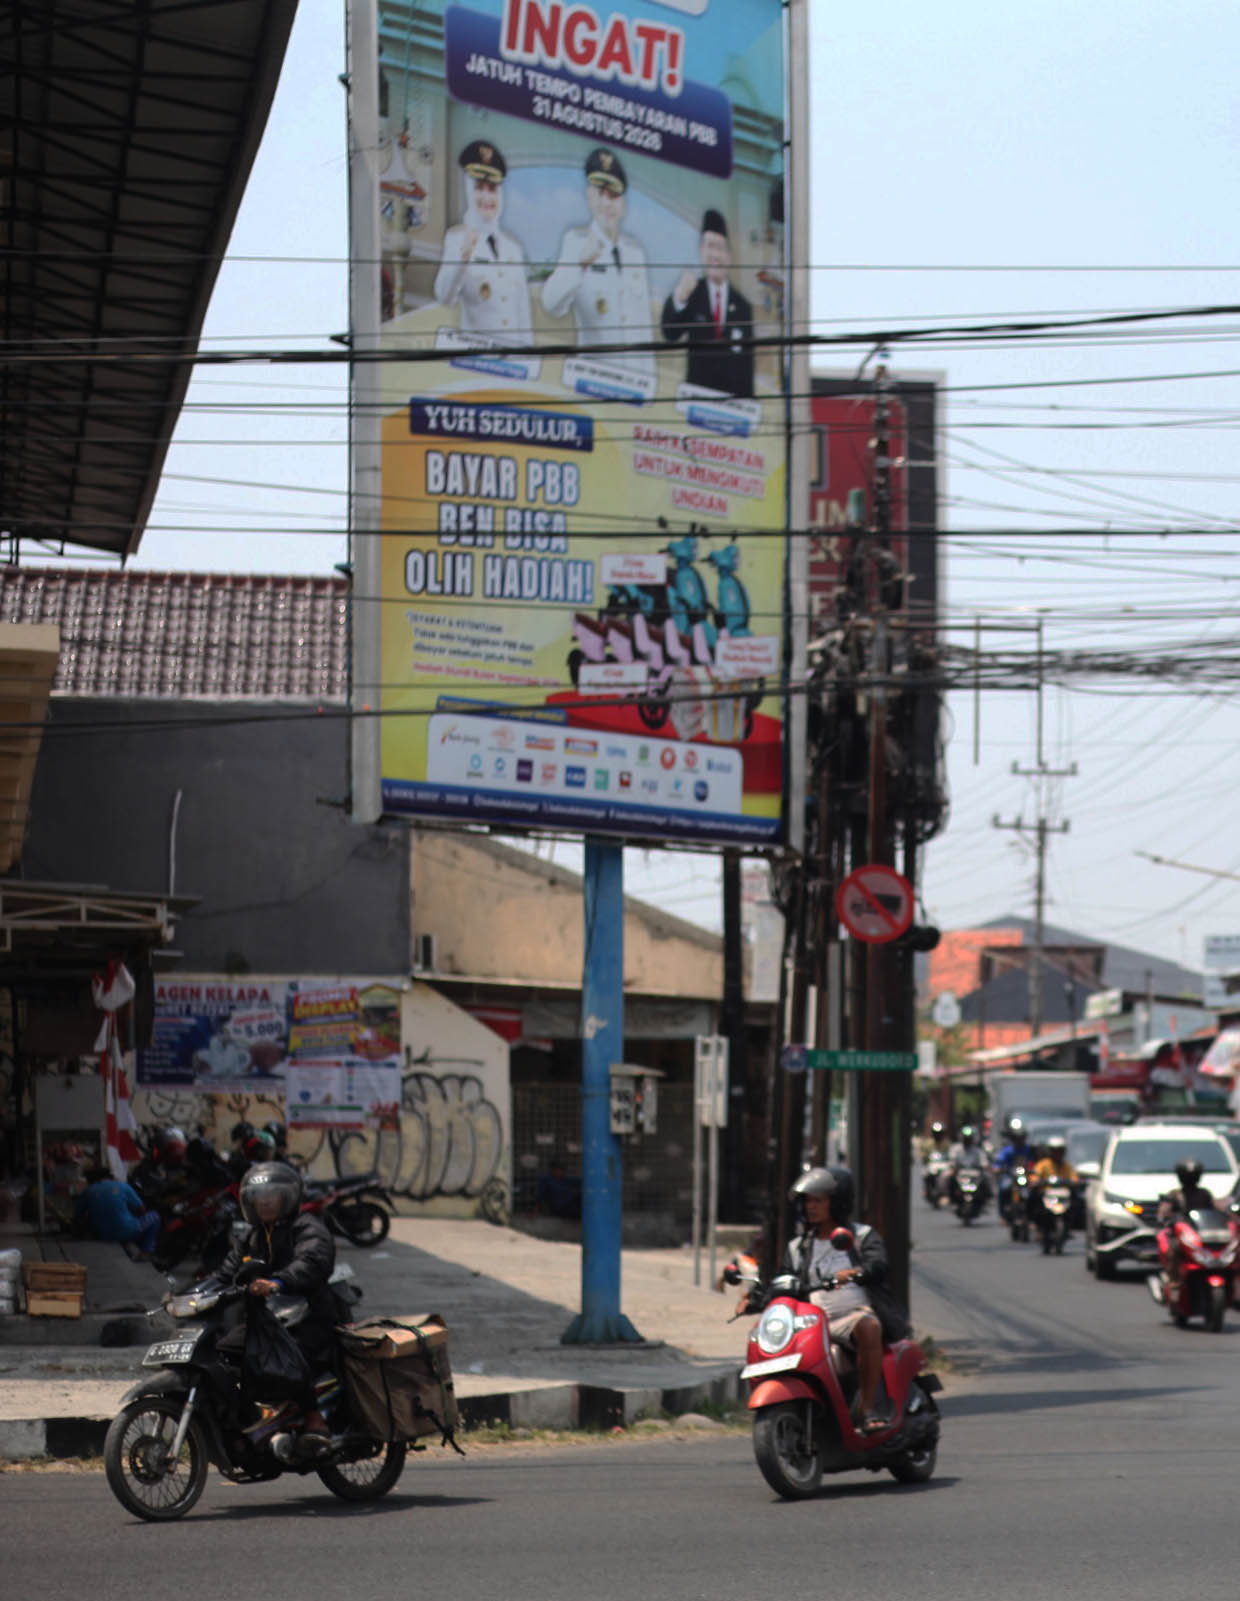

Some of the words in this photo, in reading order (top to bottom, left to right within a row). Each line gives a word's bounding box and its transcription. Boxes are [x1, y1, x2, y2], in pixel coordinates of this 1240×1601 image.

[504, 0, 684, 88] INGAT!
[465, 54, 523, 86] JATUH
[525, 70, 582, 103] TEMPO
[584, 88, 689, 137] PEMBAYARAN
[689, 120, 718, 147] PBB
[551, 100, 625, 142] AGUSTUS
[423, 404, 477, 432] YUH
[479, 410, 584, 447] SEDULUR,
[425, 449, 517, 500] BAYAR
[527, 457, 581, 506] PBB
[633, 453, 682, 476] UNTUK
[687, 466, 765, 496] MENGIKUTI
[672, 487, 728, 513] UNDIAN
[438, 502, 494, 548] BEN
[504, 507, 568, 554] BISA
[405, 550, 474, 598] OLIH
[484, 553, 596, 604] HADIAH!
[156, 985, 202, 1000] AGEN
[205, 986, 271, 1002] KELAPA
